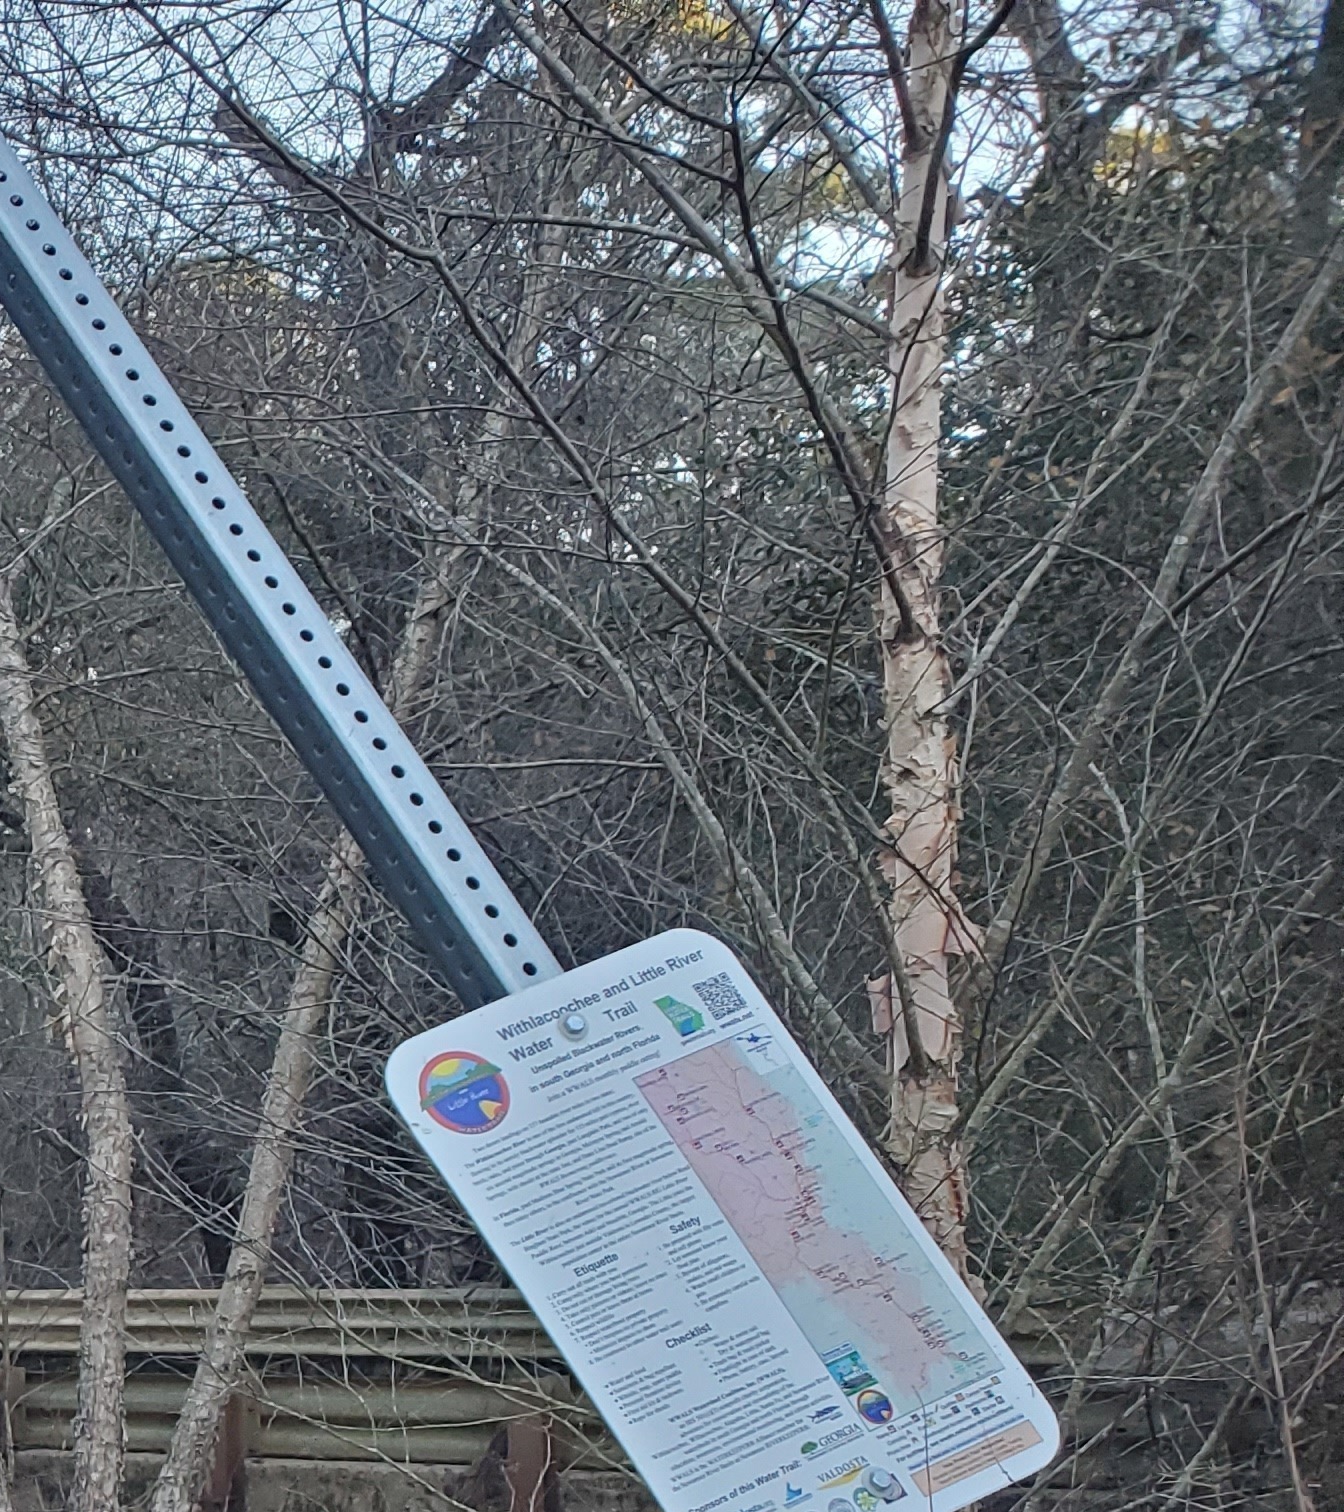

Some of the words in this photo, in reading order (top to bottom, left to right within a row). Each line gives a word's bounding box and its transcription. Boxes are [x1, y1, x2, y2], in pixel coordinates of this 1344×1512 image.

[495, 989, 603, 1042] Withlacoochee
[601, 977, 631, 998] and
[627, 962, 668, 987] Little
[664, 946, 706, 972] River
[507, 1034, 556, 1063] Water
[601, 999, 639, 1024] Trail
[527, 1083, 540, 1093] in
[537, 1073, 564, 1090] south
[561, 1059, 597, 1081] Georgia
[592, 1053, 612, 1066] and
[608, 1043, 634, 1059] north
[630, 1031, 662, 1050] Florida
[667, 1213, 704, 1237] Safety
[572, 1250, 621, 1279] Etiquette
[663, 1320, 712, 1350] Checklist
[816, 1419, 863, 1449] GEORGIA
[725, 1487, 740, 1500] of
[735, 1479, 756, 1495] this
[752, 1468, 781, 1487] Water
[777, 1457, 803, 1476] Trail:
[816, 1453, 869, 1484] VALDOSTA
